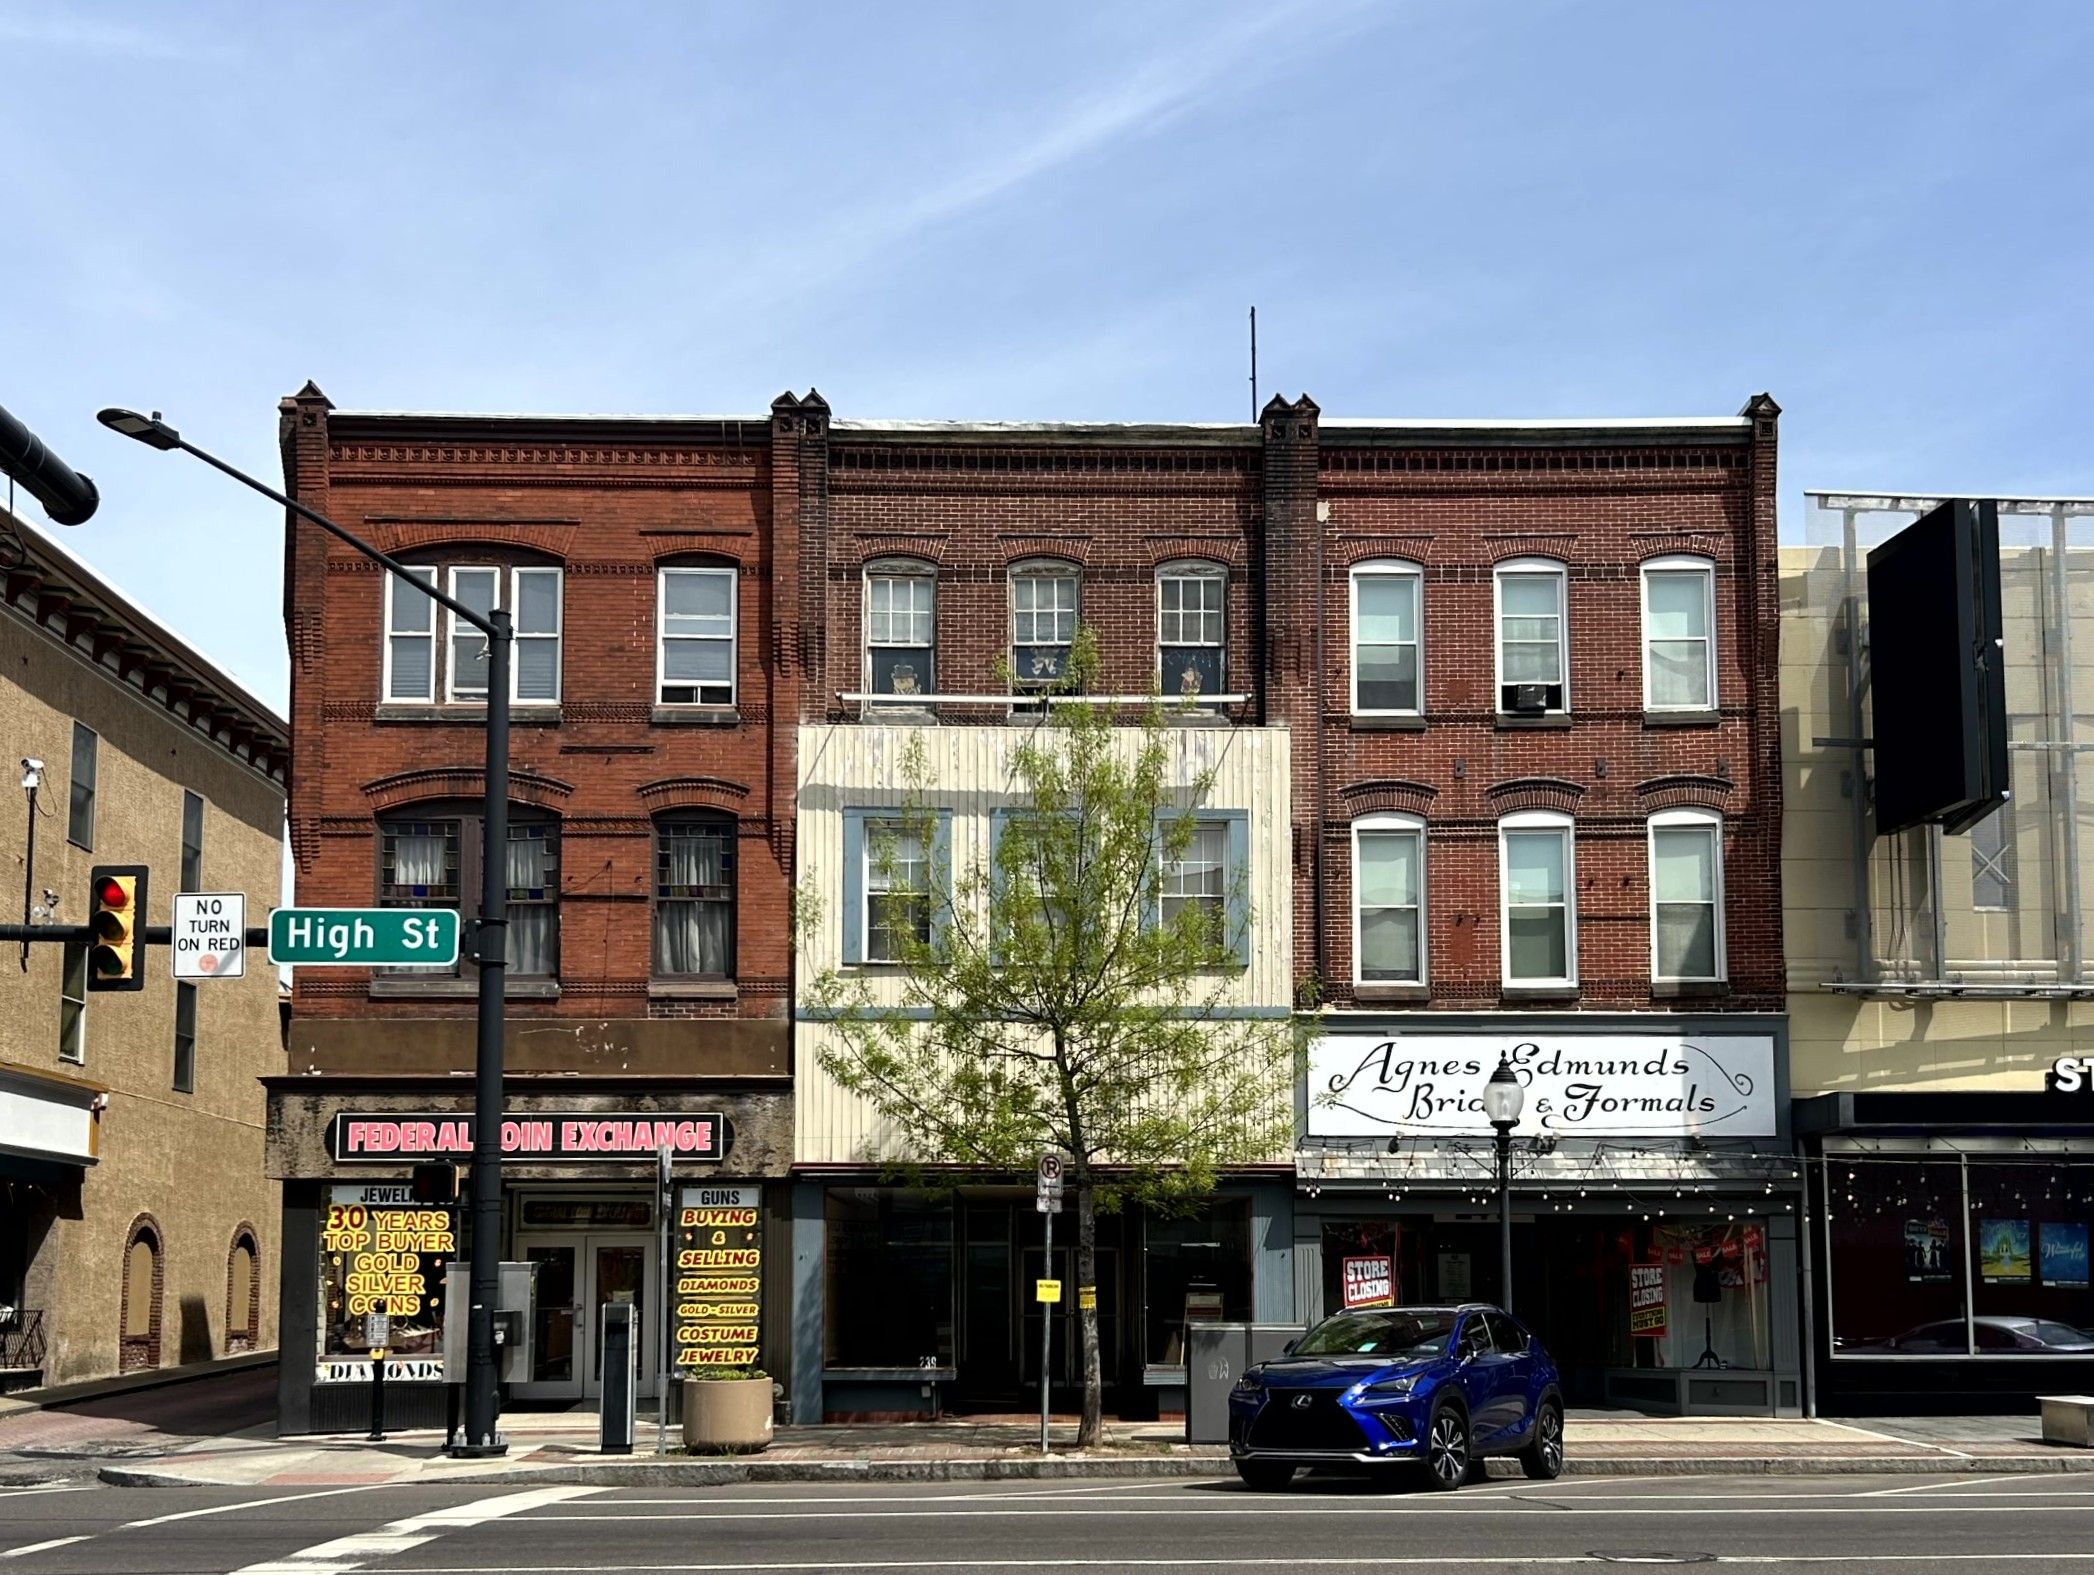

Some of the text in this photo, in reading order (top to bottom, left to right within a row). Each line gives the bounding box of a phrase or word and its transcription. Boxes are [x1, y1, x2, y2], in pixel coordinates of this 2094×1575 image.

[196, 899, 222, 915] NO
[189, 919, 230, 933] TURN
[178, 937, 240, 951] ON RED
[288, 917, 440, 958] High St
[1329, 1042, 1691, 1093] Agnes Edmunds
[1403, 1082, 1716, 1122] Bri & Formals
[348, 1120, 712, 1152] FEDERAL OIN EXCHANGE
[360, 1187, 415, 1202] JEWEL
[701, 1190, 740, 1206] GUNS
[328, 1205, 450, 1231] 30 YEARS
[681, 1209, 756, 1227] BUYING
[325, 1232, 454, 1252] TOP BUYER
[712, 1231, 726, 1245] &
[354, 1253, 419, 1273] GOLD
[678, 1250, 760, 1267] SELLING
[1346, 1260, 1389, 1282] STORE
[1631, 1267, 1663, 1289] STORE
[346, 1273, 426, 1294] SILVER
[678, 1278, 760, 1293] DIAMONDS
[1348, 1279, 1390, 1302] CLOSING
[350, 1295, 420, 1316] COINS
[1632, 1286, 1664, 1308] CLOSING
[678, 1304, 709, 1317] GOLD
[717, 1304, 759, 1317] SILVER
[677, 1326, 759, 1343] COSTUME
[676, 1348, 759, 1365] JEWELRY
[329, 1363, 444, 1379] DIAONDS
